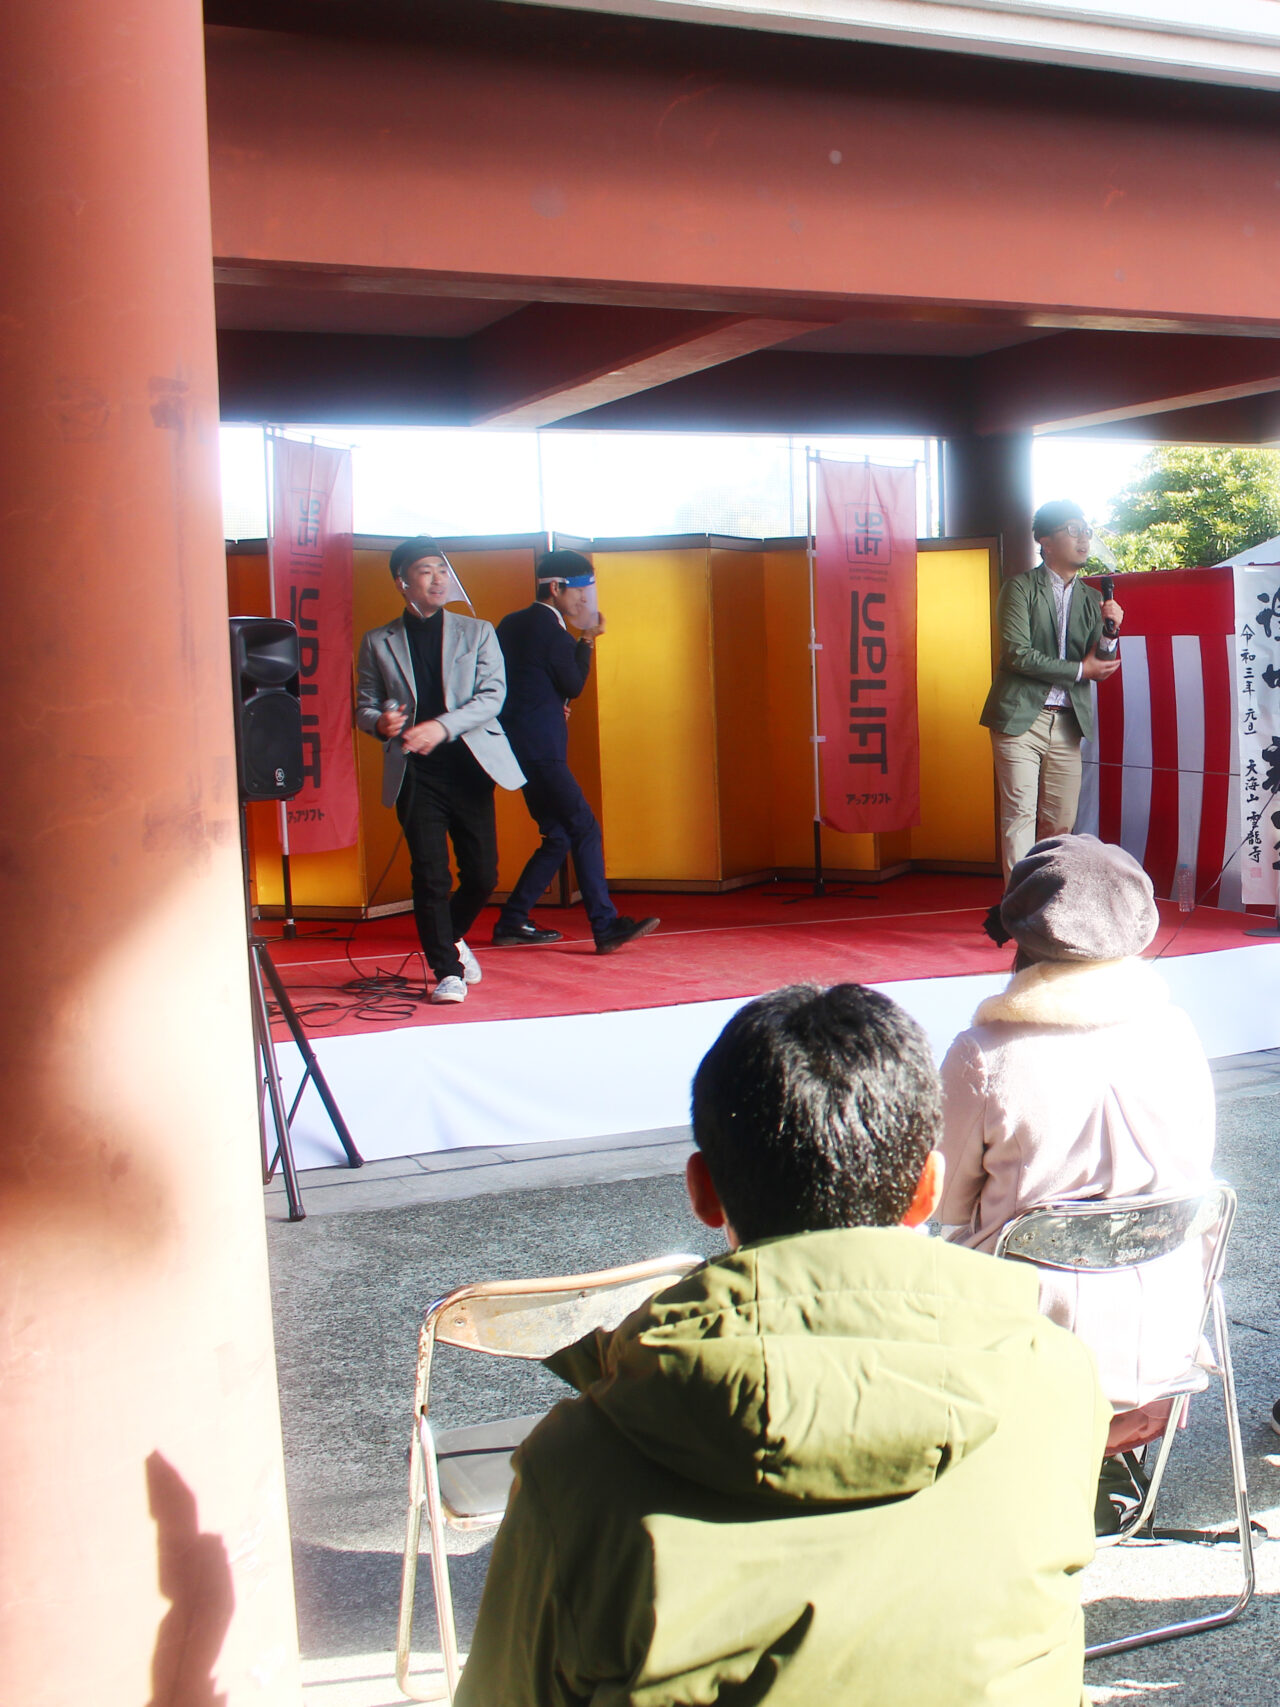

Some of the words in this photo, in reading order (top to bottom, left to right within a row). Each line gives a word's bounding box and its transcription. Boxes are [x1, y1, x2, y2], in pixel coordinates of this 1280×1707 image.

[848, 592, 888, 774] UPLIFT
[846, 793, 892, 806] アップリフト
